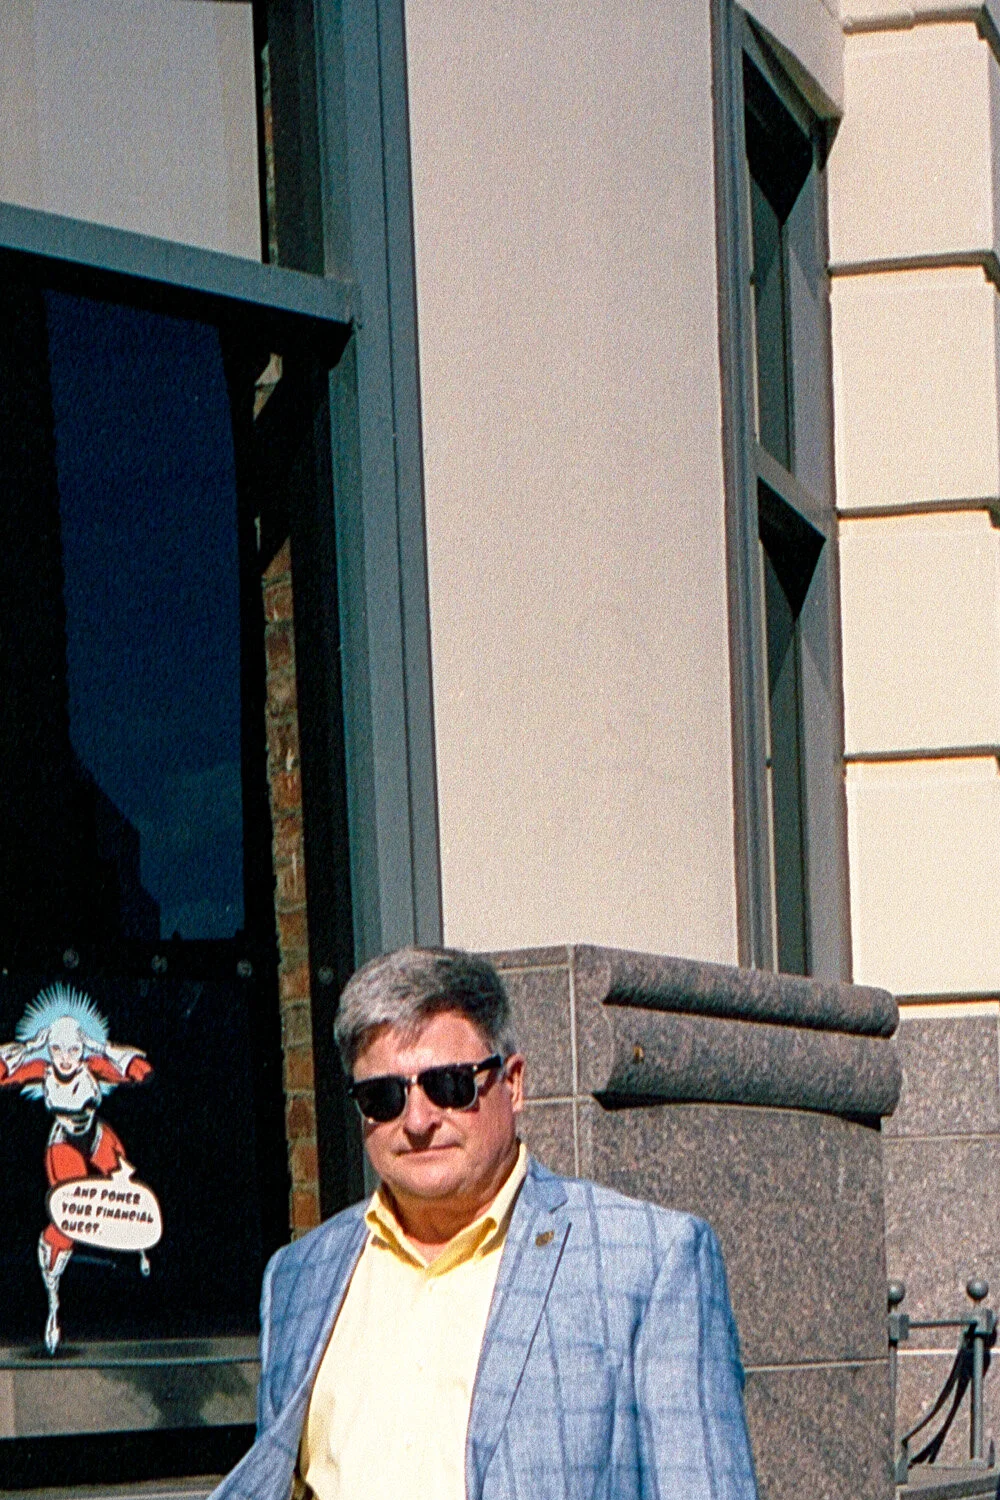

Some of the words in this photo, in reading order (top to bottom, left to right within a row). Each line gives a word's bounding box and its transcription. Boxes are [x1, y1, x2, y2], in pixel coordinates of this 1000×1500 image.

[101, 1189, 141, 1205] POWER
[62, 1202, 93, 1216] YOUR
[96, 1206, 154, 1224] FINANCIAL
